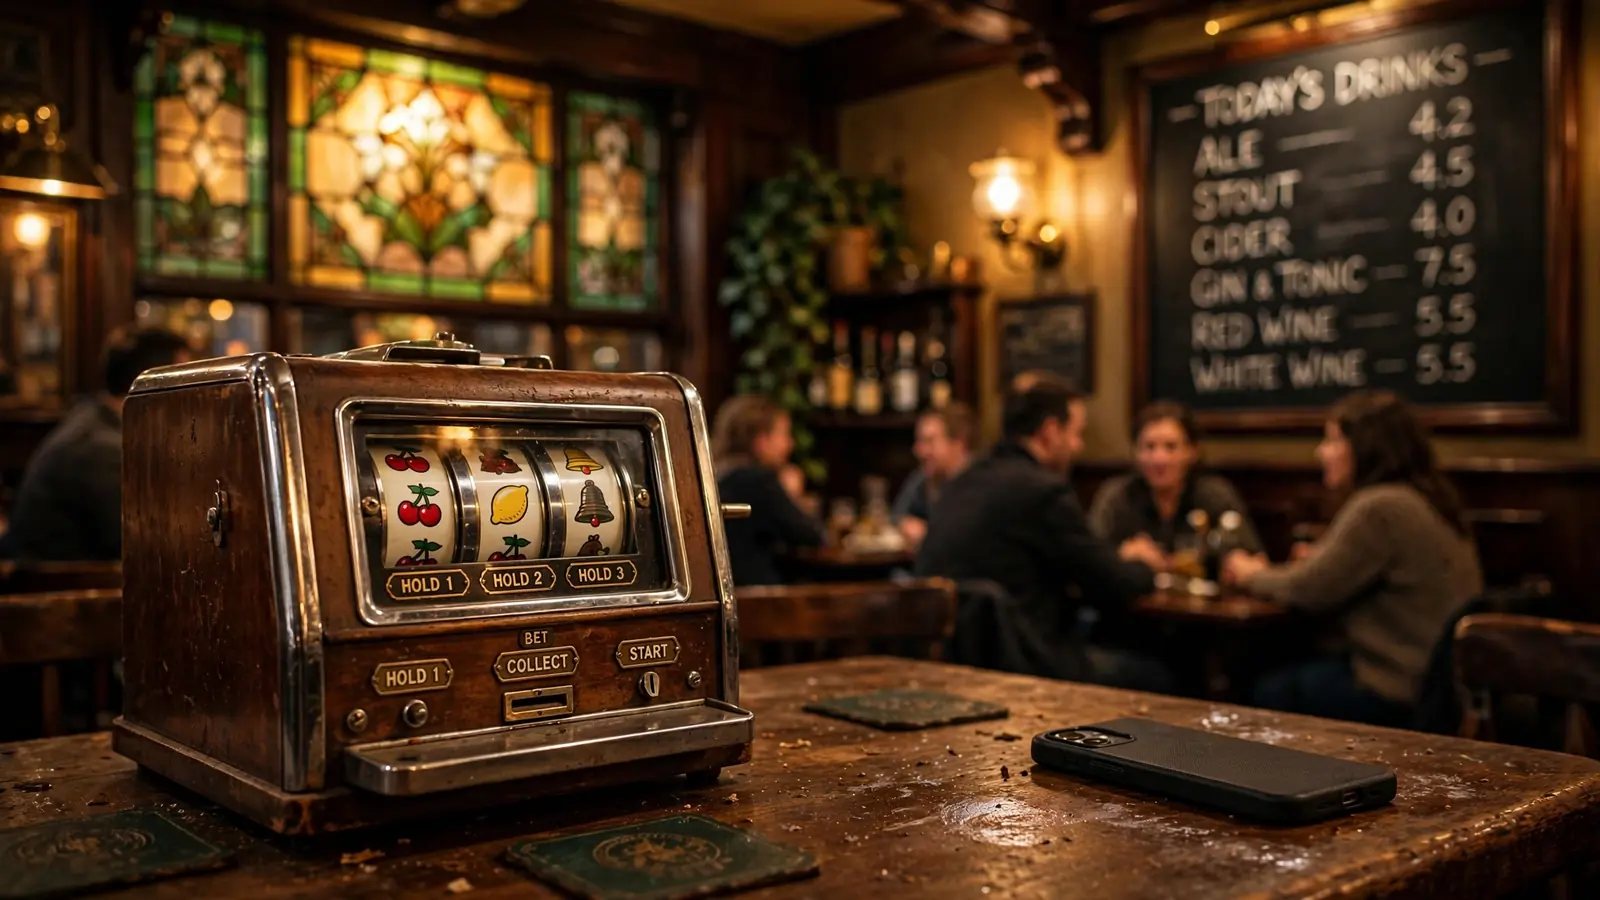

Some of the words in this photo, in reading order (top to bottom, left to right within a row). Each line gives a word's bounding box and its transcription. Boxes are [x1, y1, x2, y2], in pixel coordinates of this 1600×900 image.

[1195, 65, 1325, 127] TODAY'S
[1334, 43, 1469, 106] DRINKS
[1193, 129, 1263, 177] ALE
[1409, 96, 1475, 141] 4.2
[1193, 169, 1302, 221] STOUT
[1409, 145, 1475, 190] 4.5
[1191, 217, 1294, 265] CIDER
[1410, 195, 1476, 239] 4.0
[1190, 268, 1248, 308] GIN
[1275, 254, 1367, 298] TONIC
[1414, 243, 1477, 288] 7.5
[1191, 311, 1254, 350] RED
[1258, 305, 1339, 346] WINE
[1415, 292, 1477, 337] 5.5
[1189, 353, 1282, 393] WHITE
[1287, 348, 1366, 390] WINE
[1415, 341, 1477, 385] 5.5
[401, 577, 440, 593] HOLD
[446, 576, 453, 591] 1
[493, 573, 529, 588] HOLD
[534, 571, 542, 585] 2
[578, 568, 612, 582] HOLD
[616, 566, 625, 580] 3
[524, 630, 548, 645] BET
[629, 643, 668, 661] START
[386, 668, 427, 687] HOLD
[432, 667, 439, 682] 1
[507, 653, 568, 674] COLLECT
